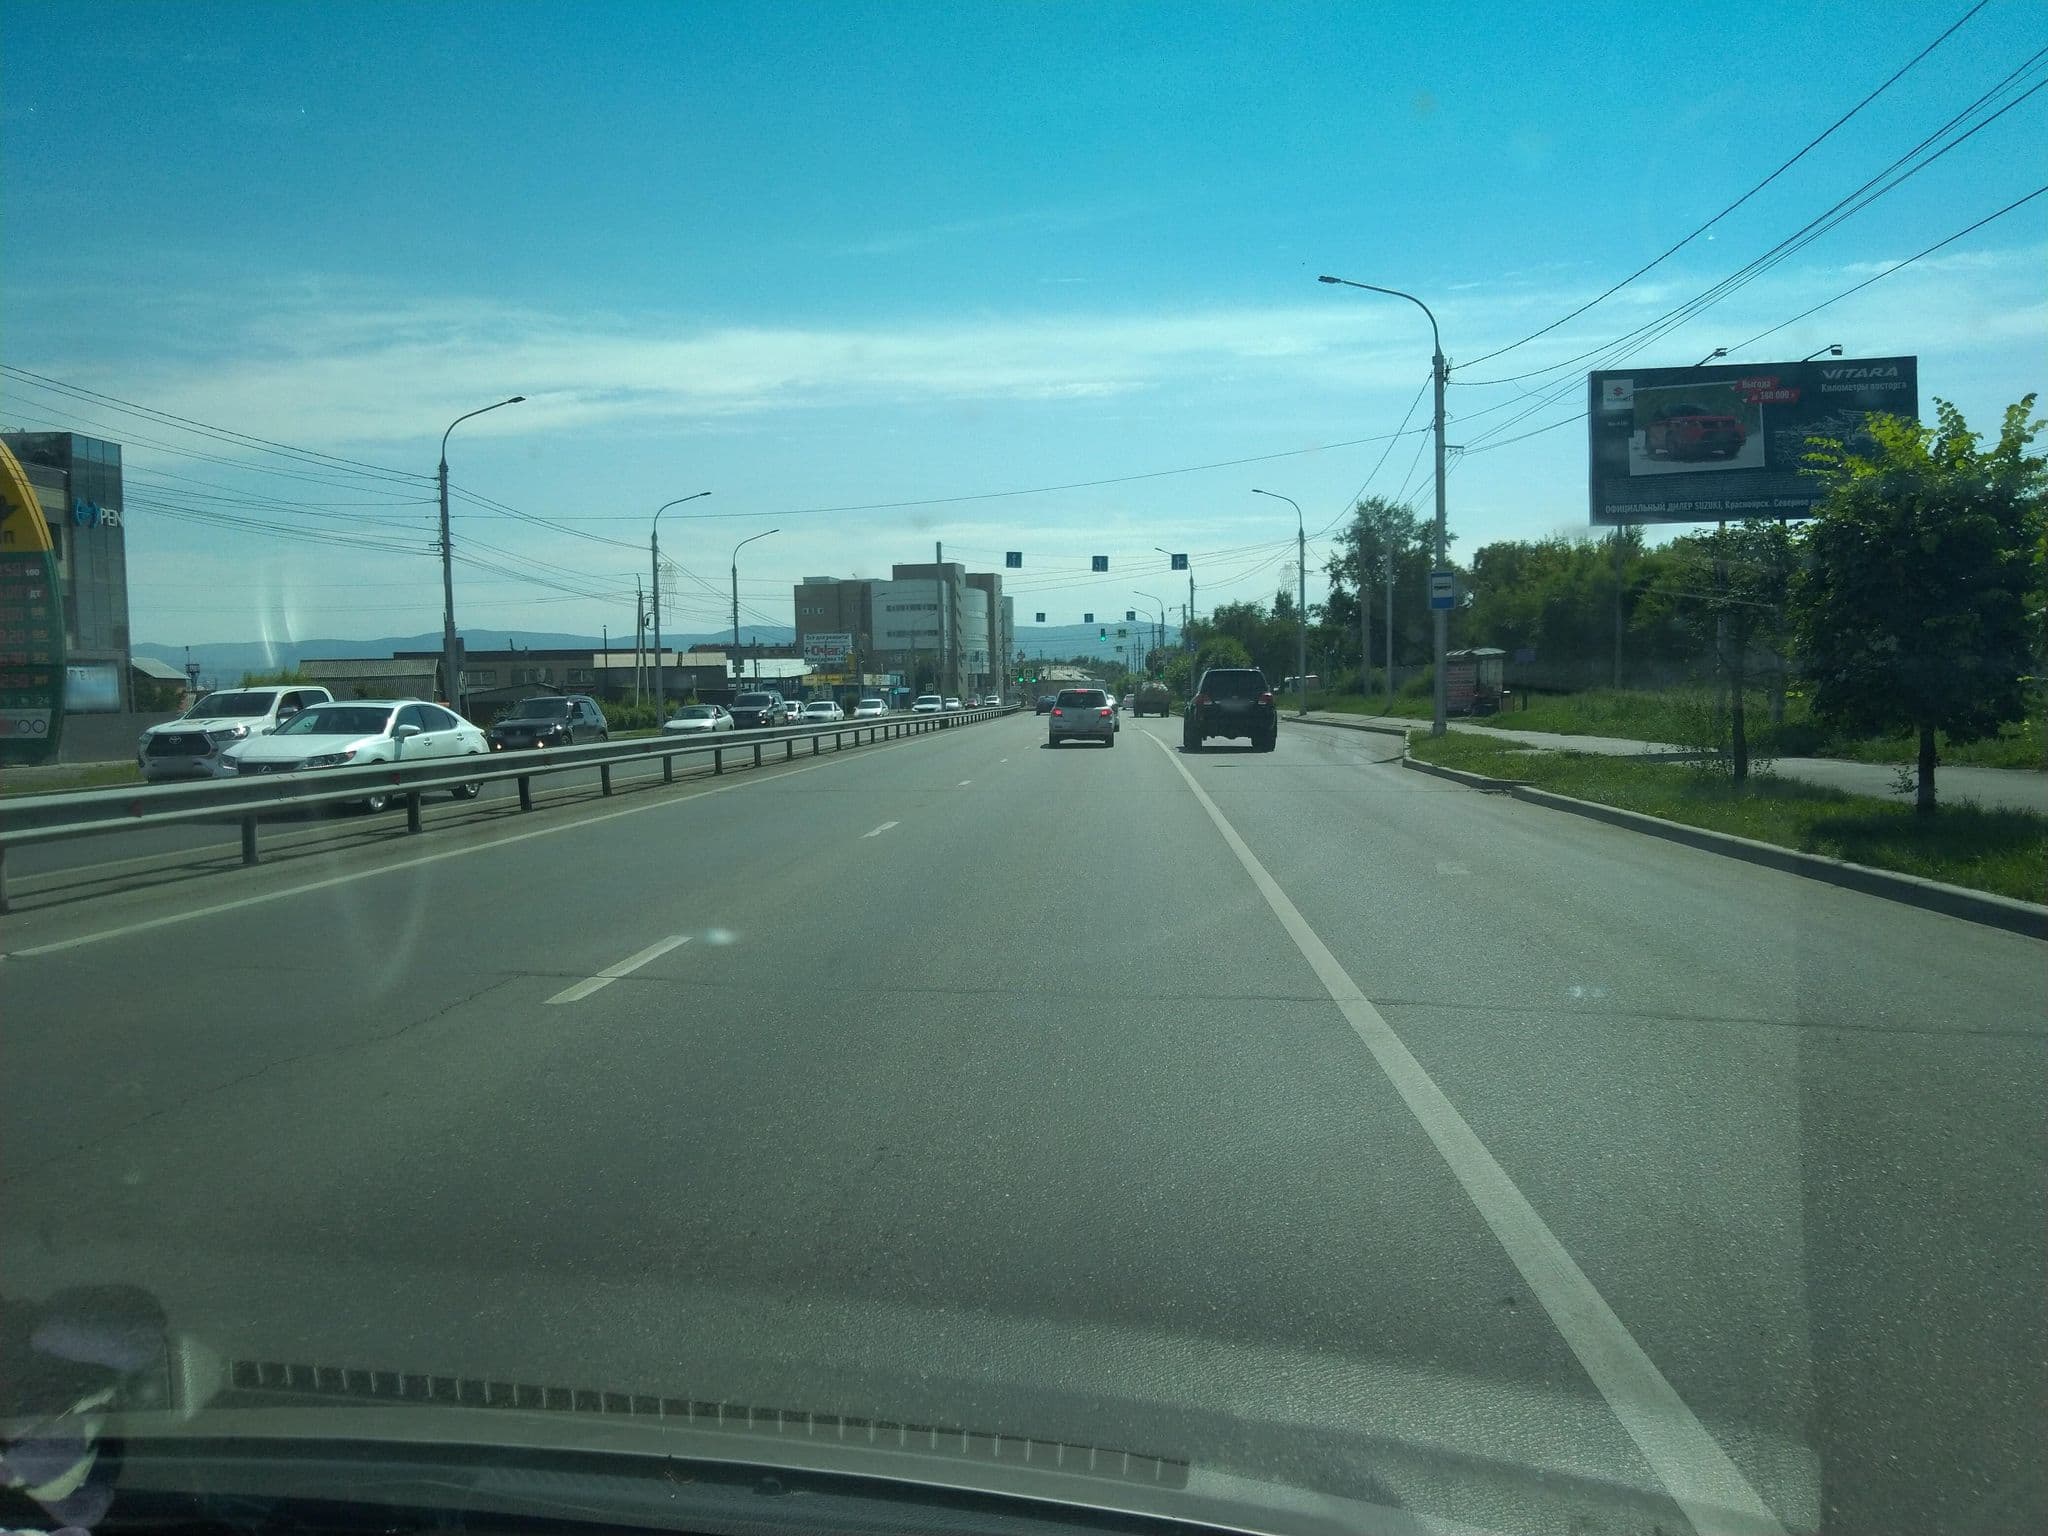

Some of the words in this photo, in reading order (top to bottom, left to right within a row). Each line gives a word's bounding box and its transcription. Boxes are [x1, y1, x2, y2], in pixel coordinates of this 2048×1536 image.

[1822, 366, 1898, 380] VITARA
[1742, 380, 1771, 389] Выгода
[1822, 383, 1868, 393] Километры
[1605, 502, 1666, 514] ОФИЦИАЛЬНЫЙ
[1667, 501, 1693, 513] ДИЛЕР
[25, 568, 40, 577] 100
